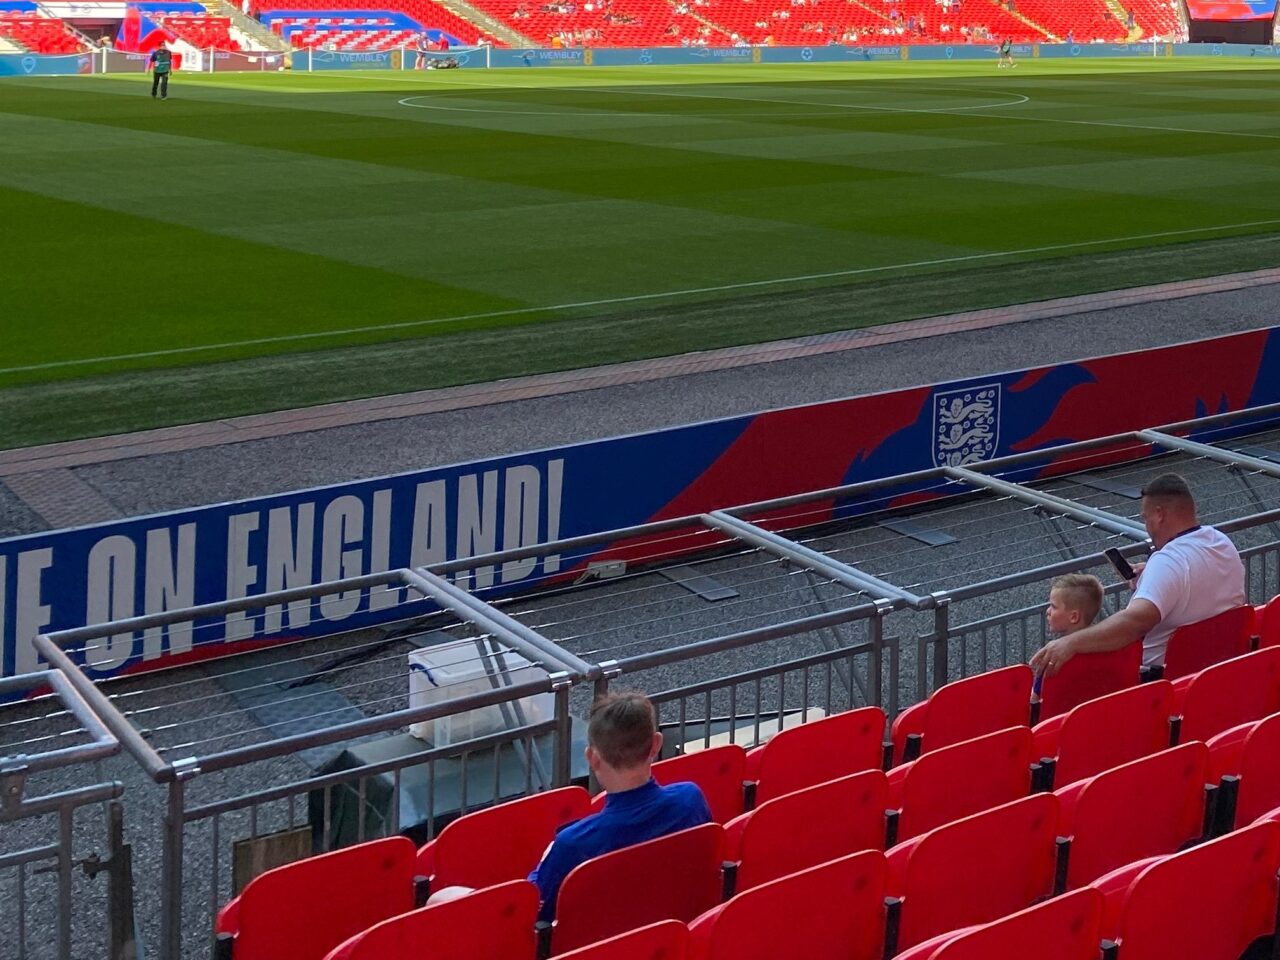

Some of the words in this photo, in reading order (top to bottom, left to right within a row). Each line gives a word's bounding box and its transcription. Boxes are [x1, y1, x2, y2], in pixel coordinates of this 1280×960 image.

[539, 51, 582, 60] WEMBLEY
[713, 48, 751, 57] WEMBLEY
[340, 53, 388, 63] WEMBLEY
[85, 522, 197, 671] ON
[225, 459, 565, 642] ENGLAND!
